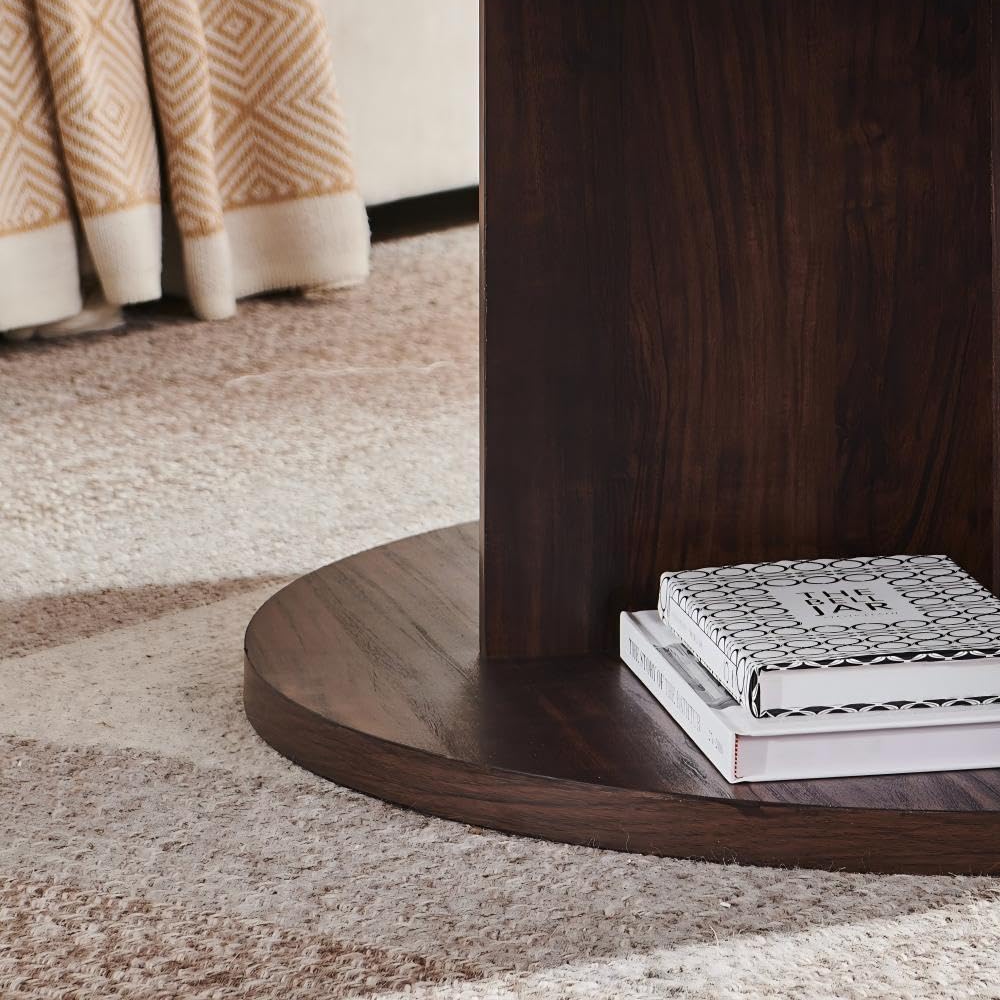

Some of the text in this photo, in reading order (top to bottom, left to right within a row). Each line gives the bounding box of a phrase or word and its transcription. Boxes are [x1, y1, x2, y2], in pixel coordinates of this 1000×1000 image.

[796, 588, 875, 598] THE
[805, 595, 884, 606] BELL
[813, 602, 892, 616] JAR
